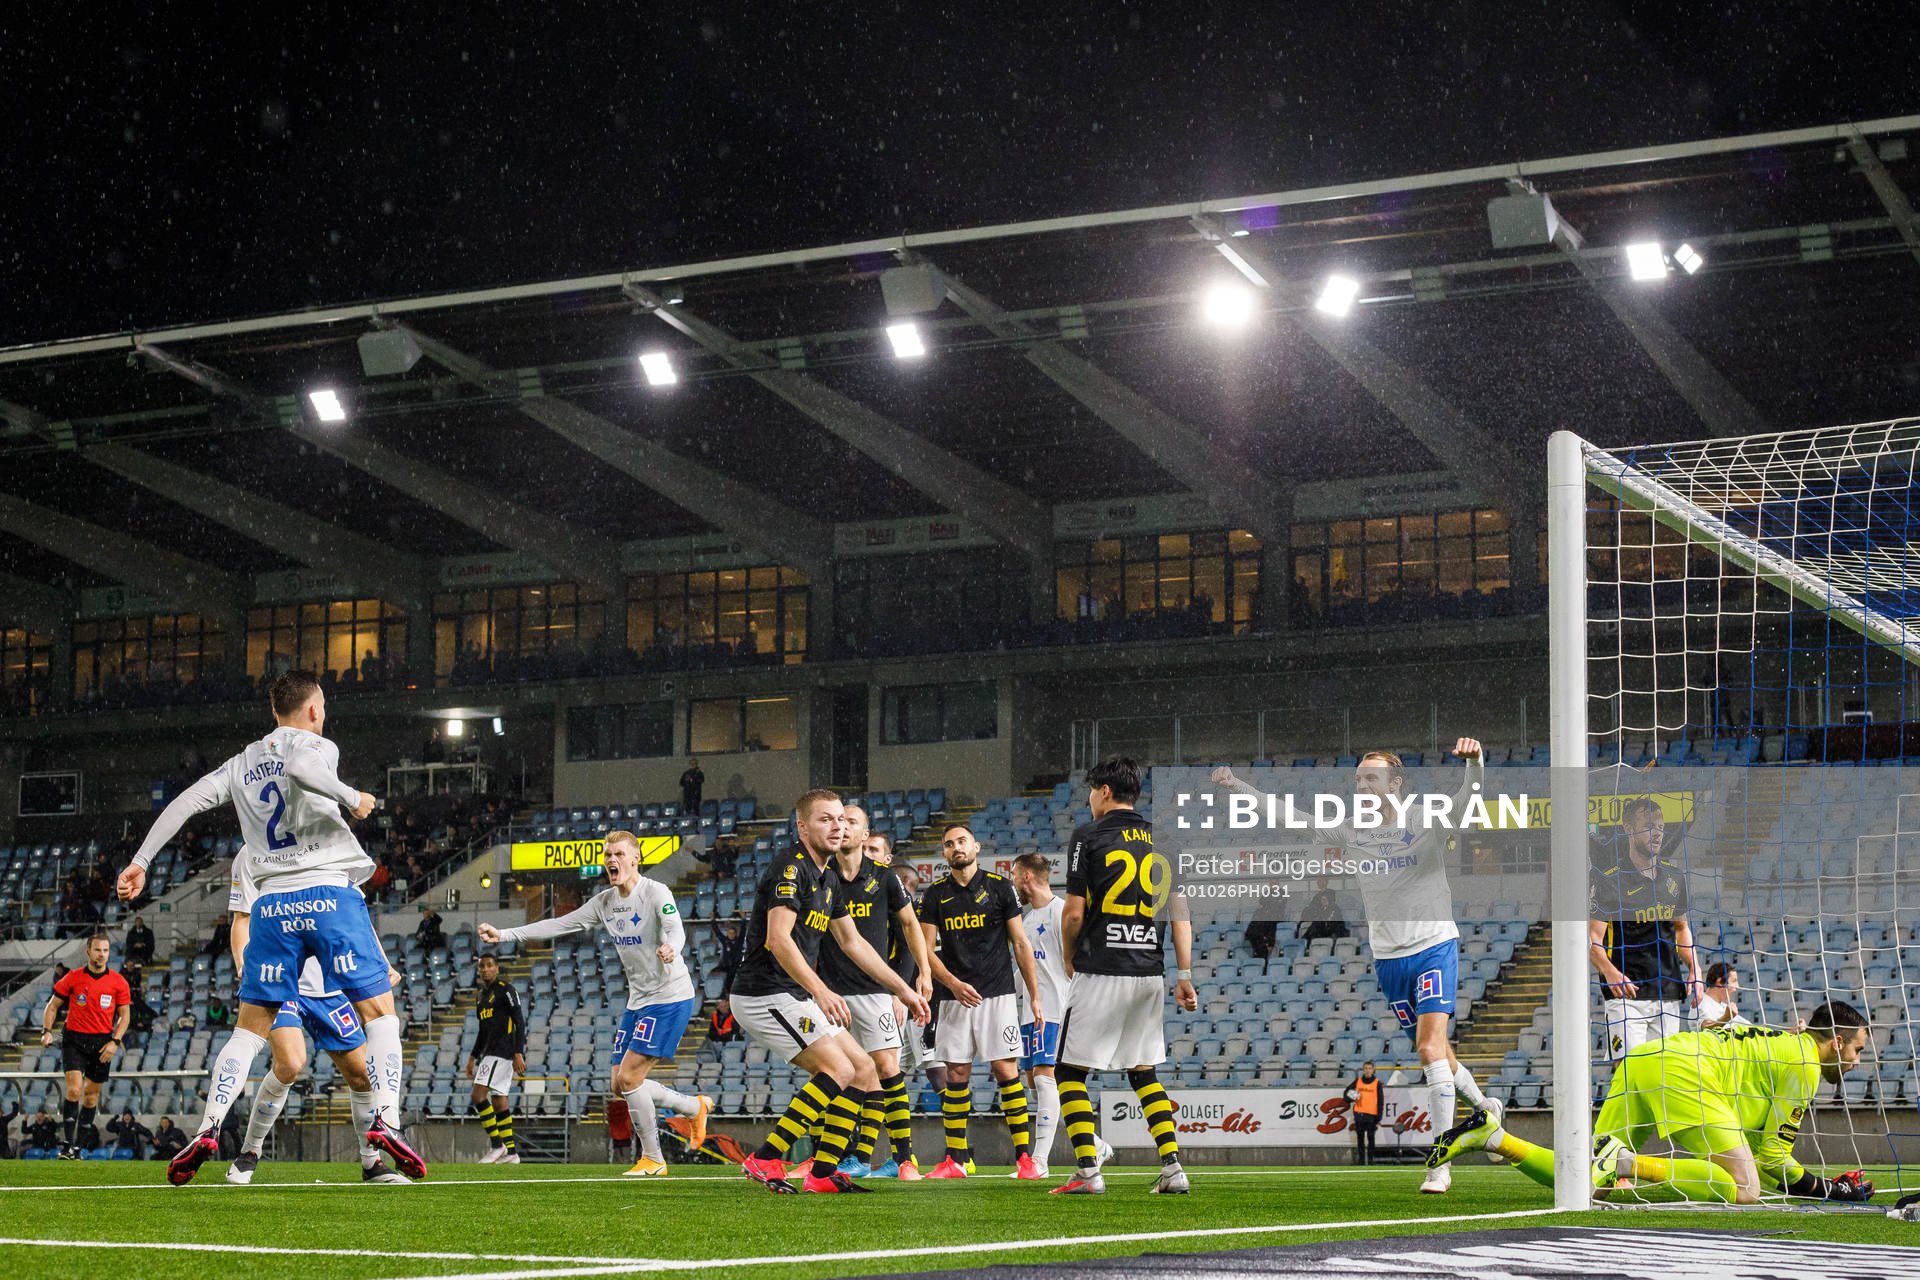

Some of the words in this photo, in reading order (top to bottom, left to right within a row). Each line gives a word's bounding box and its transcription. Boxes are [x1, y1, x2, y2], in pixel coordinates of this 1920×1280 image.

[260, 781, 297, 850] 2
[1122, 828, 1153, 845] KAHL
[1102, 849, 1172, 918] 29
[260, 899, 337, 919] MÅNSSON
[846, 900, 873, 917] tar
[1635, 902, 1676, 924] notar
[280, 916, 318, 933] RÖR
[805, 909, 830, 932] notar
[944, 912, 986, 931] notar
[1106, 923, 1158, 943] SVEA
